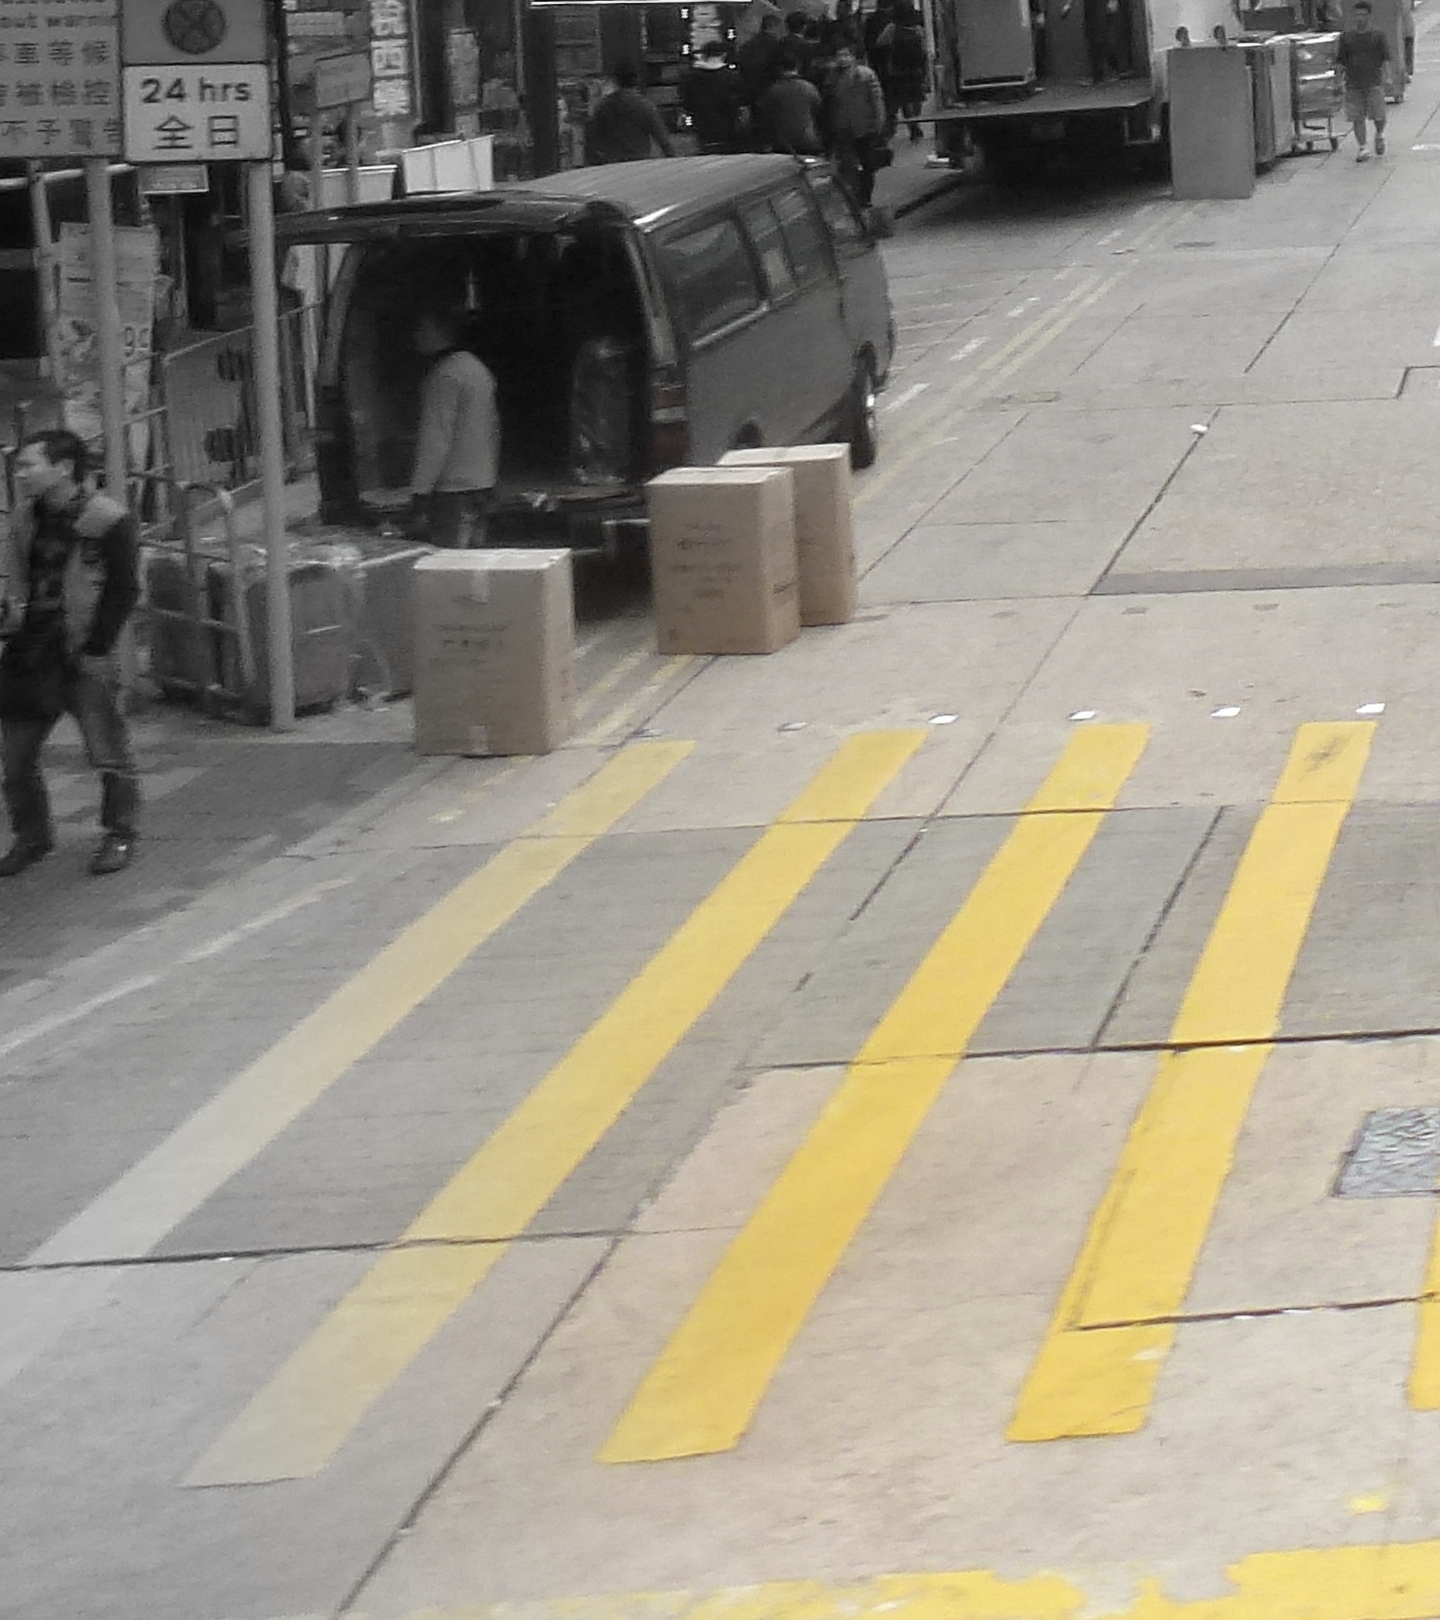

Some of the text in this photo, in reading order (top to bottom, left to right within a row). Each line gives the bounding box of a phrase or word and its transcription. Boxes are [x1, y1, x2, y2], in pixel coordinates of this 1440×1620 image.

[140, 78, 186, 105] 24
[200, 77, 251, 103] hrs
[153, 114, 241, 151] 全日
